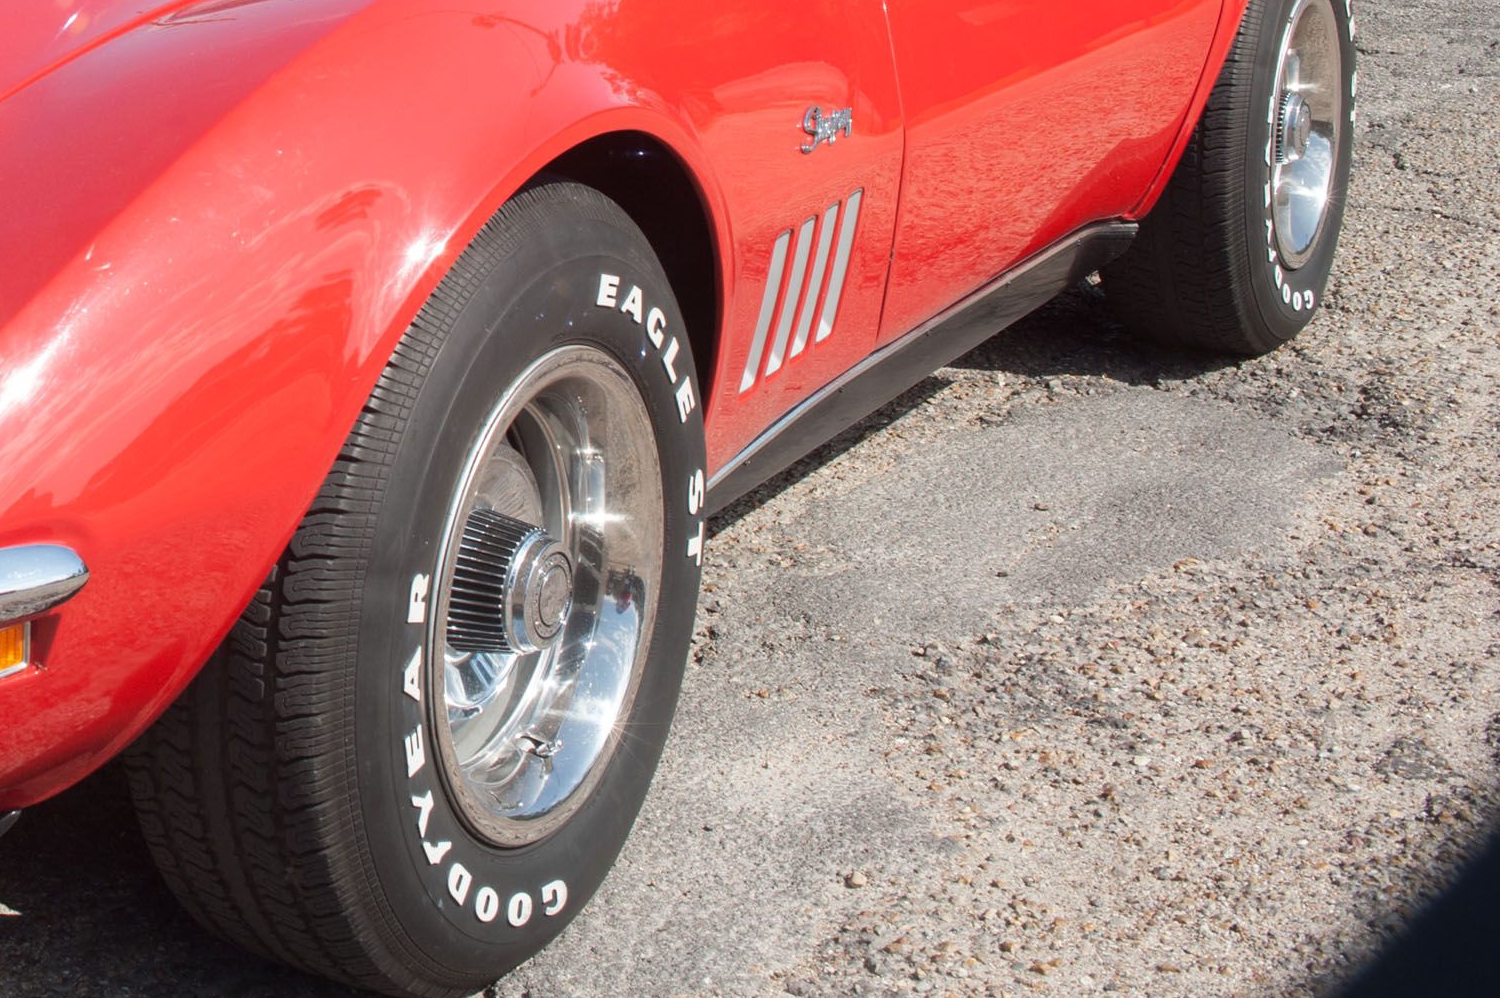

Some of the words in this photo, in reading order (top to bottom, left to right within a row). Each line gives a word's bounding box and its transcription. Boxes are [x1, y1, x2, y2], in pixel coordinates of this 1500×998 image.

[596, 273, 695, 423] EAGLE
[687, 468, 705, 567] ST
[403, 573, 568, 928] GOODYEAR
